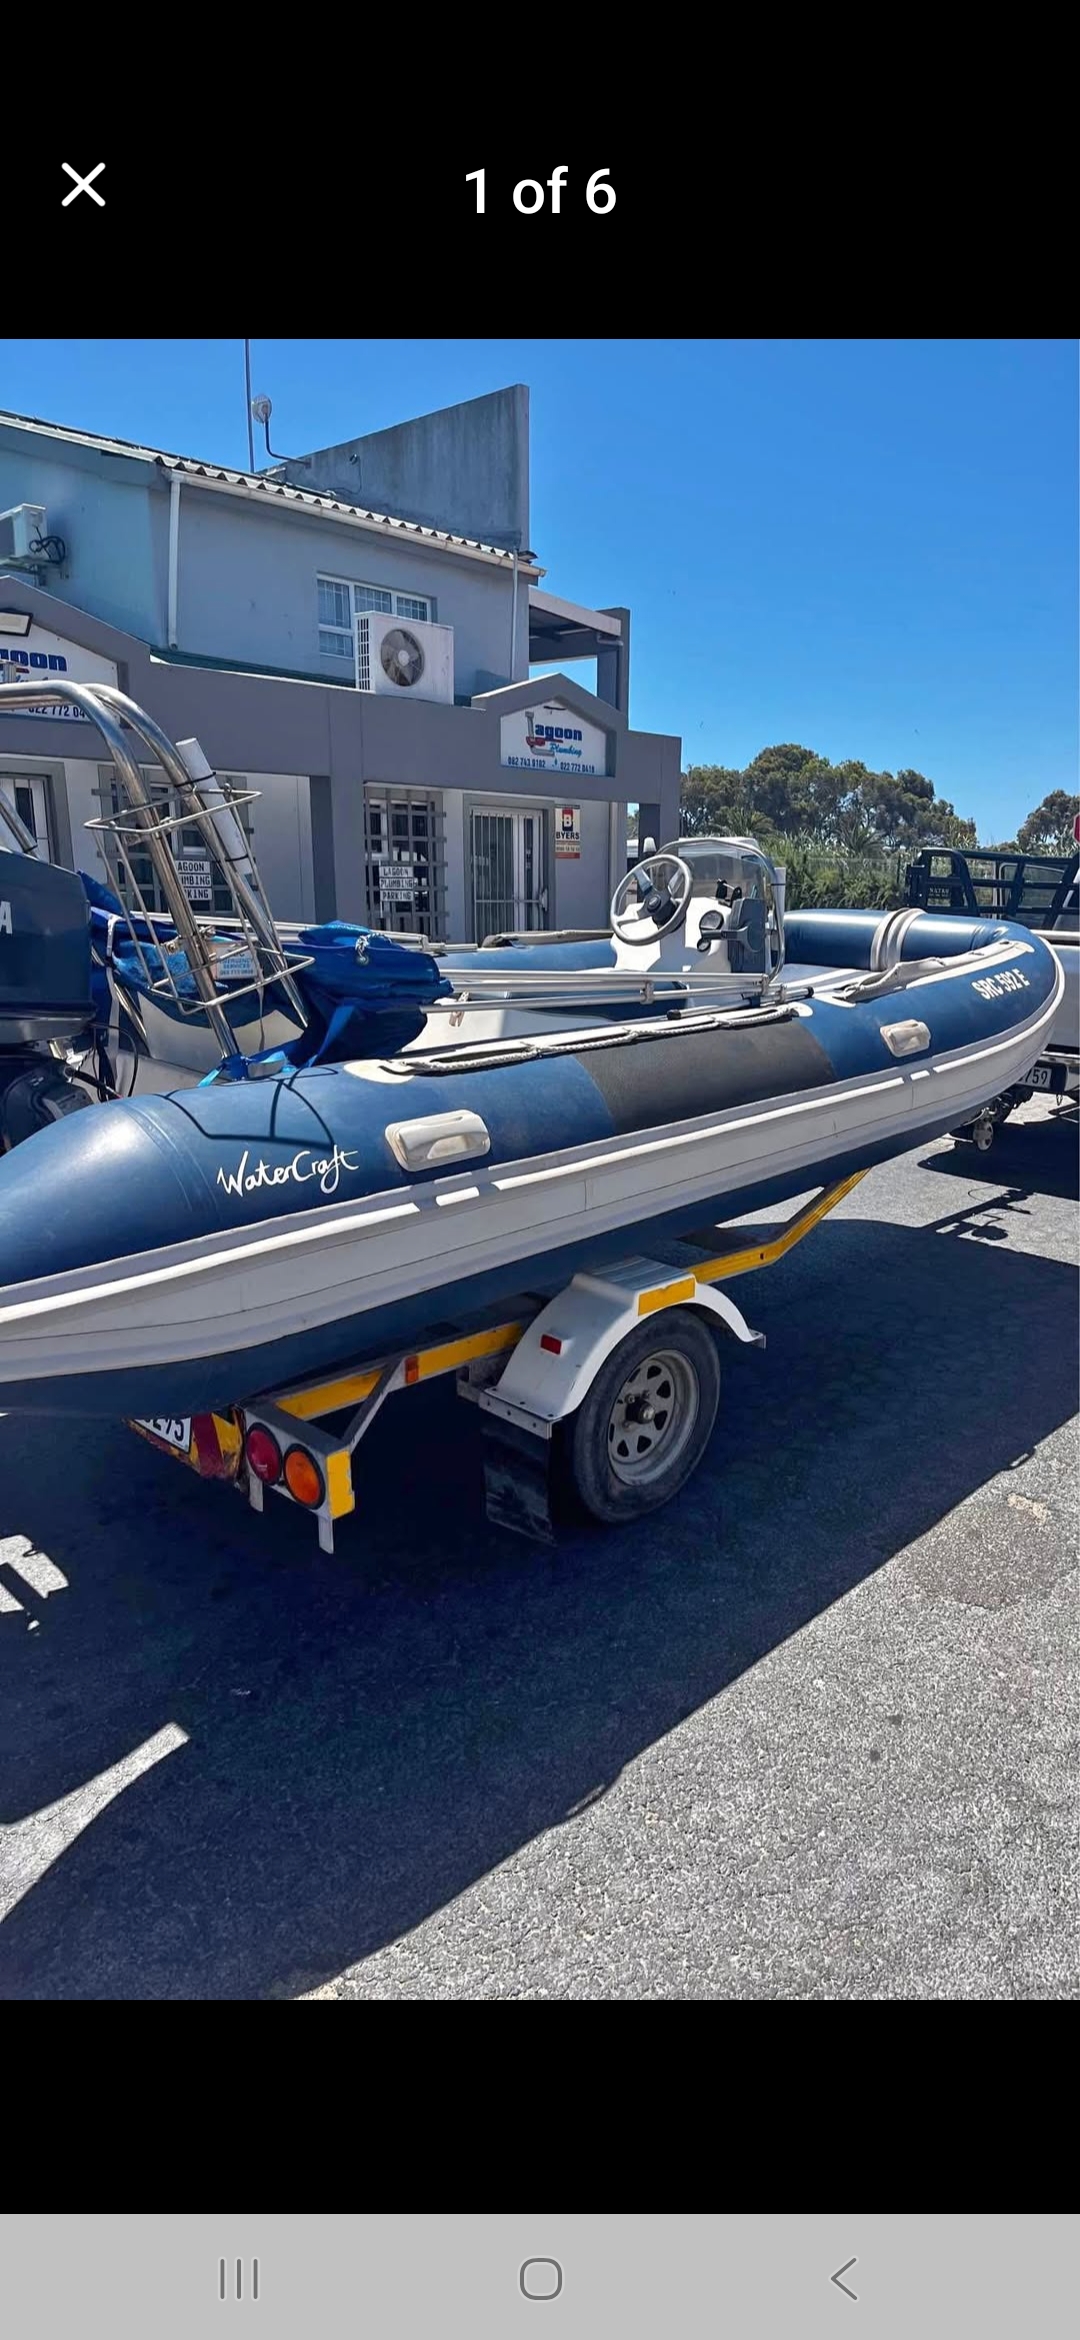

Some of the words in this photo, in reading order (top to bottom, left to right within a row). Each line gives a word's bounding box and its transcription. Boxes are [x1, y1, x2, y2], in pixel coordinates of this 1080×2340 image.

[549, 742, 582, 758] Plumbing
[555, 831, 580, 840] BYERS
[177, 861, 205, 872] AGOON
[383, 867, 409, 876] LAGOON
[380, 879, 413, 888] PLUMBING
[382, 891, 411, 900] PARKING
[971, 977, 1004, 1000] SRC
[993, 971, 1023, 992] 592
[1011, 968, 1030, 986] E
[217, 1145, 358, 1196] WaterCraft
